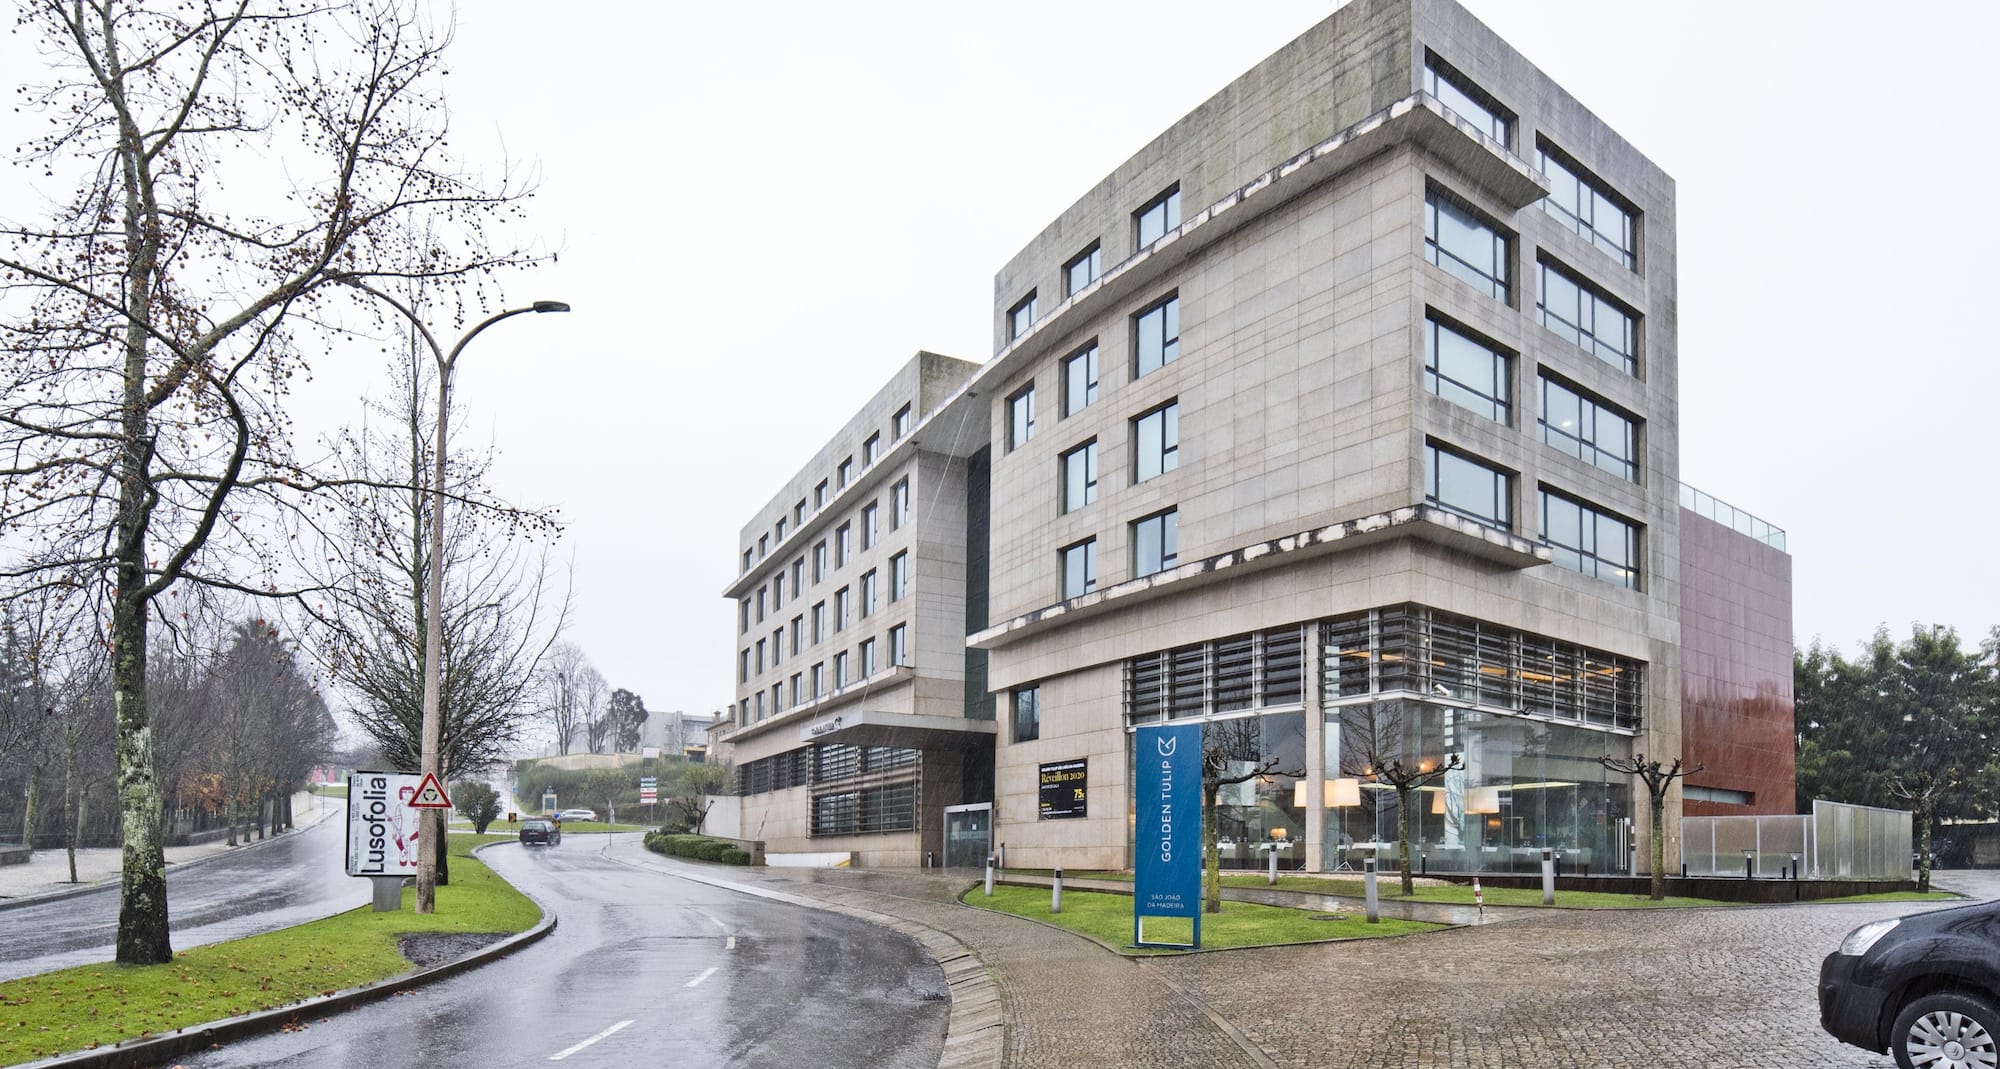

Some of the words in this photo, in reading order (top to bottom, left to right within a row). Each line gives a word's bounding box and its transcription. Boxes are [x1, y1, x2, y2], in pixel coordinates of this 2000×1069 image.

[1070, 771, 1085, 781] 2020
[1161, 760, 1171, 799] TULIP
[361, 777, 387, 873] Lusofolia
[1161, 804, 1171, 862] GOLDEN
